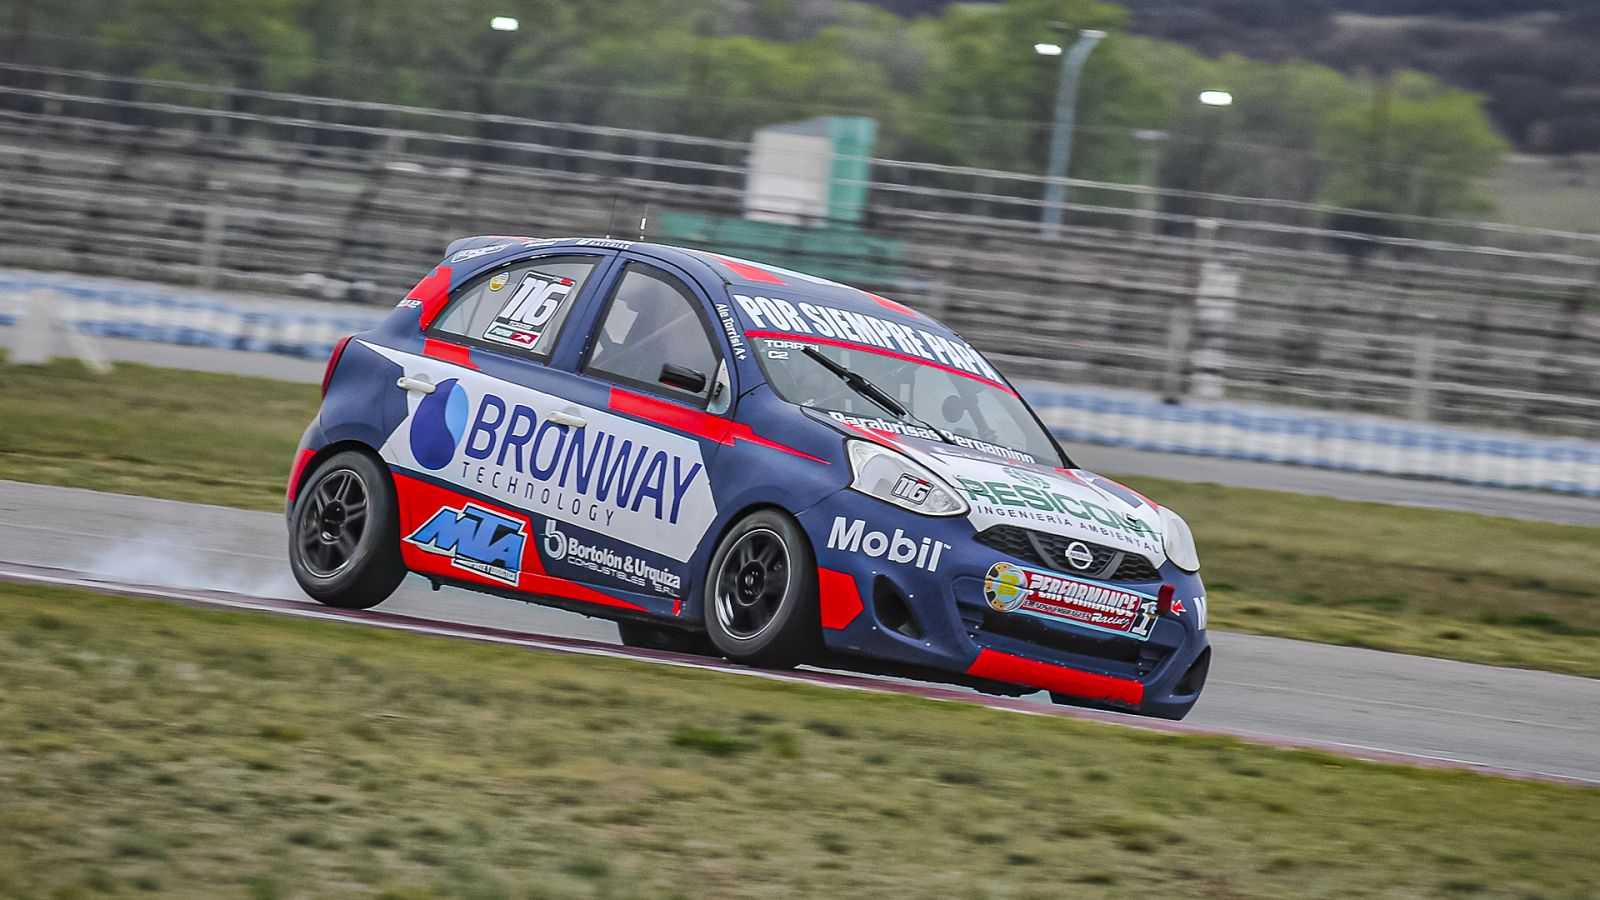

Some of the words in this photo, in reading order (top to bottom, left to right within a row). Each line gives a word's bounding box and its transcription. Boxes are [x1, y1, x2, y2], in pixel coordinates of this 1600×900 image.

[499, 277, 574, 327] 116
[715, 303, 730, 318] Ale
[734, 347, 748, 361] A+
[733, 294, 813, 334] POR
[798, 301, 934, 361] SIEMPRE
[918, 328, 1004, 385] PAPÁ
[767, 350, 790, 360] C2
[828, 411, 943, 441] Parabrisas
[939, 429, 1036, 464] Pergamino
[464, 393, 702, 525] BRONWAY
[462, 461, 615, 526] TECHNOLOGY
[894, 479, 931, 502] 116
[957, 475, 1160, 542] RESICOM
[409, 506, 526, 572] MTA
[977, 505, 1073, 526] INGENIERÍA
[1080, 522, 1160, 554] AMBIENTAL
[567, 556, 646, 587] COMBUSTIBLES
[568, 537, 623, 569] Bortolón
[623, 555, 635, 573] &
[635, 558, 681, 589] Urquiza
[1027, 573, 1138, 616] PERFORMANCE
[1090, 613, 1130, 629] Racing
